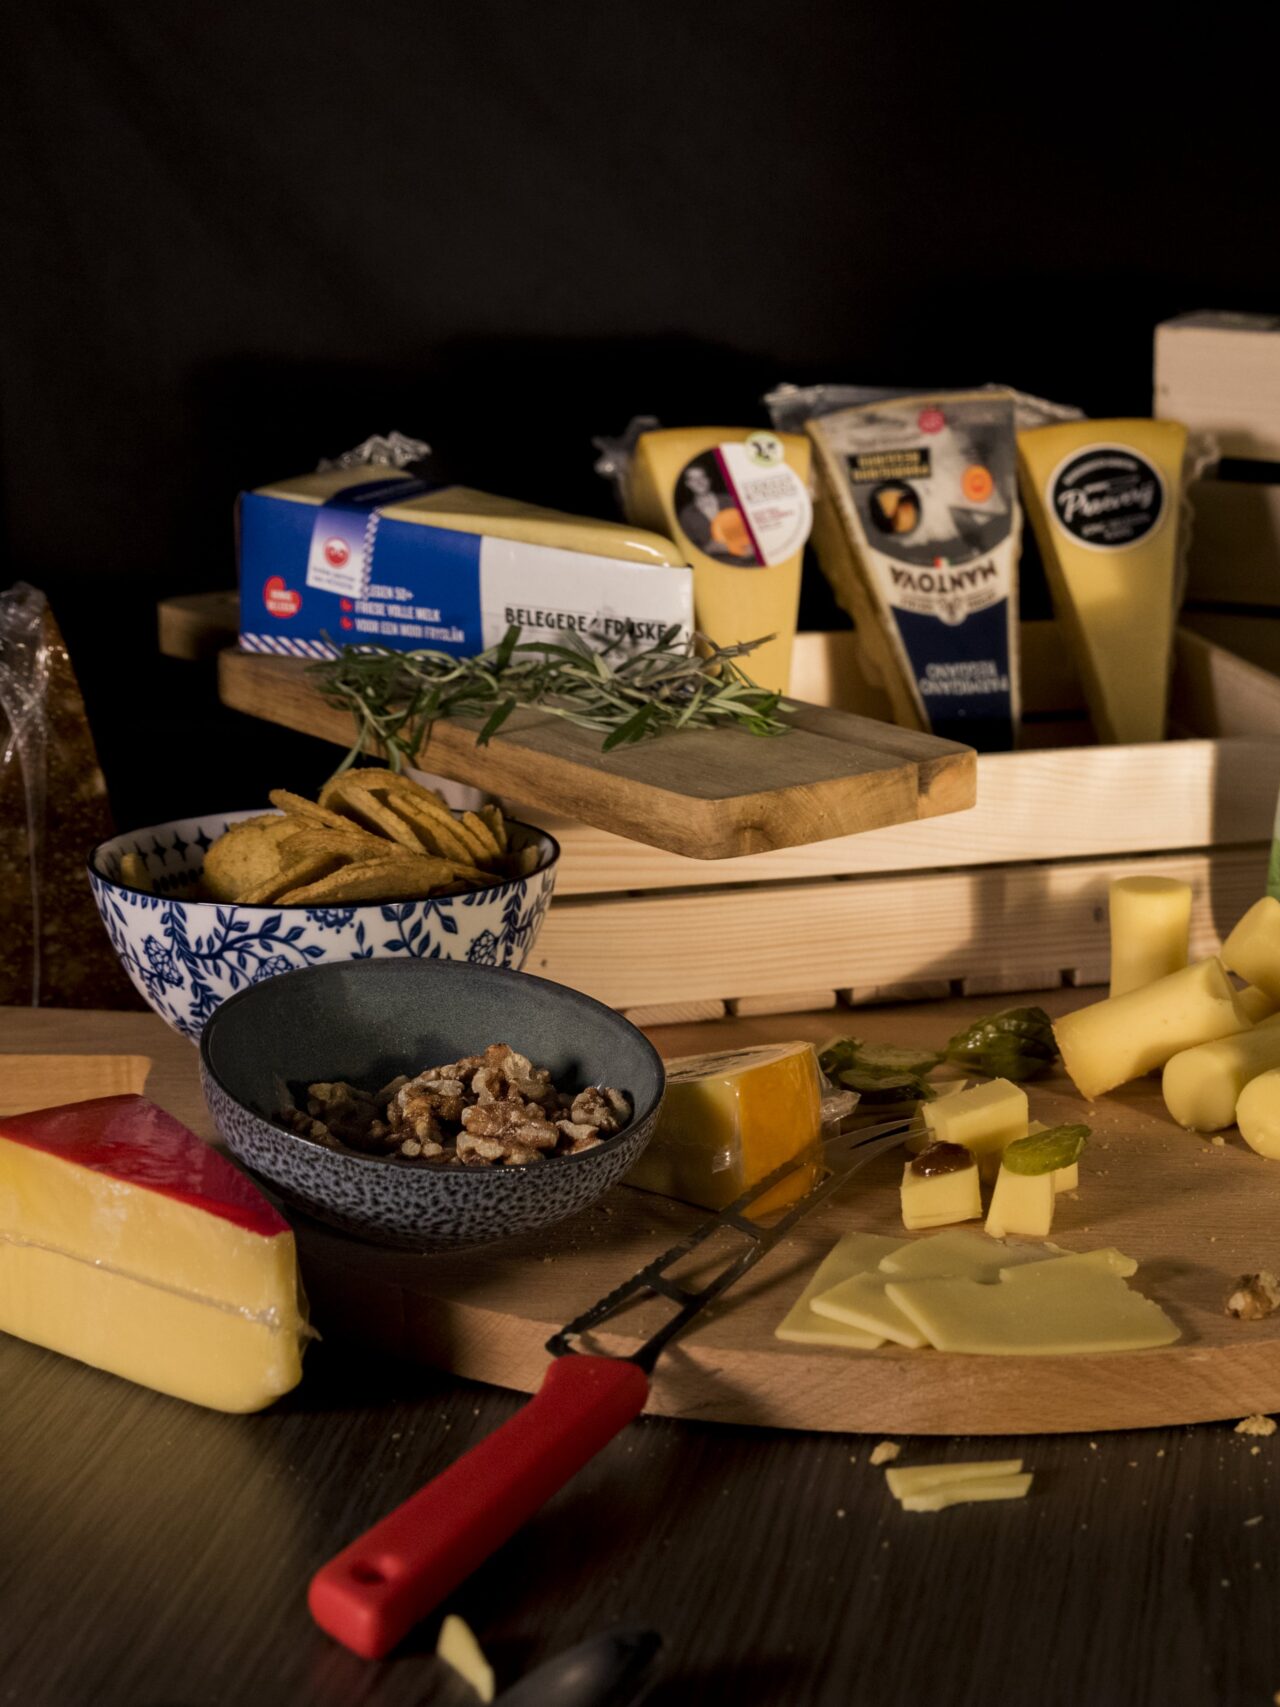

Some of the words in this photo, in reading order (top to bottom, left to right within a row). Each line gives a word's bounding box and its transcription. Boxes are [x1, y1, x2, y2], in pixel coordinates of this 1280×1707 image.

[889, 559, 997, 593] MANTOVA
[504, 607, 587, 633] BELEGERE
[604, 617, 668, 641] FRSKE
